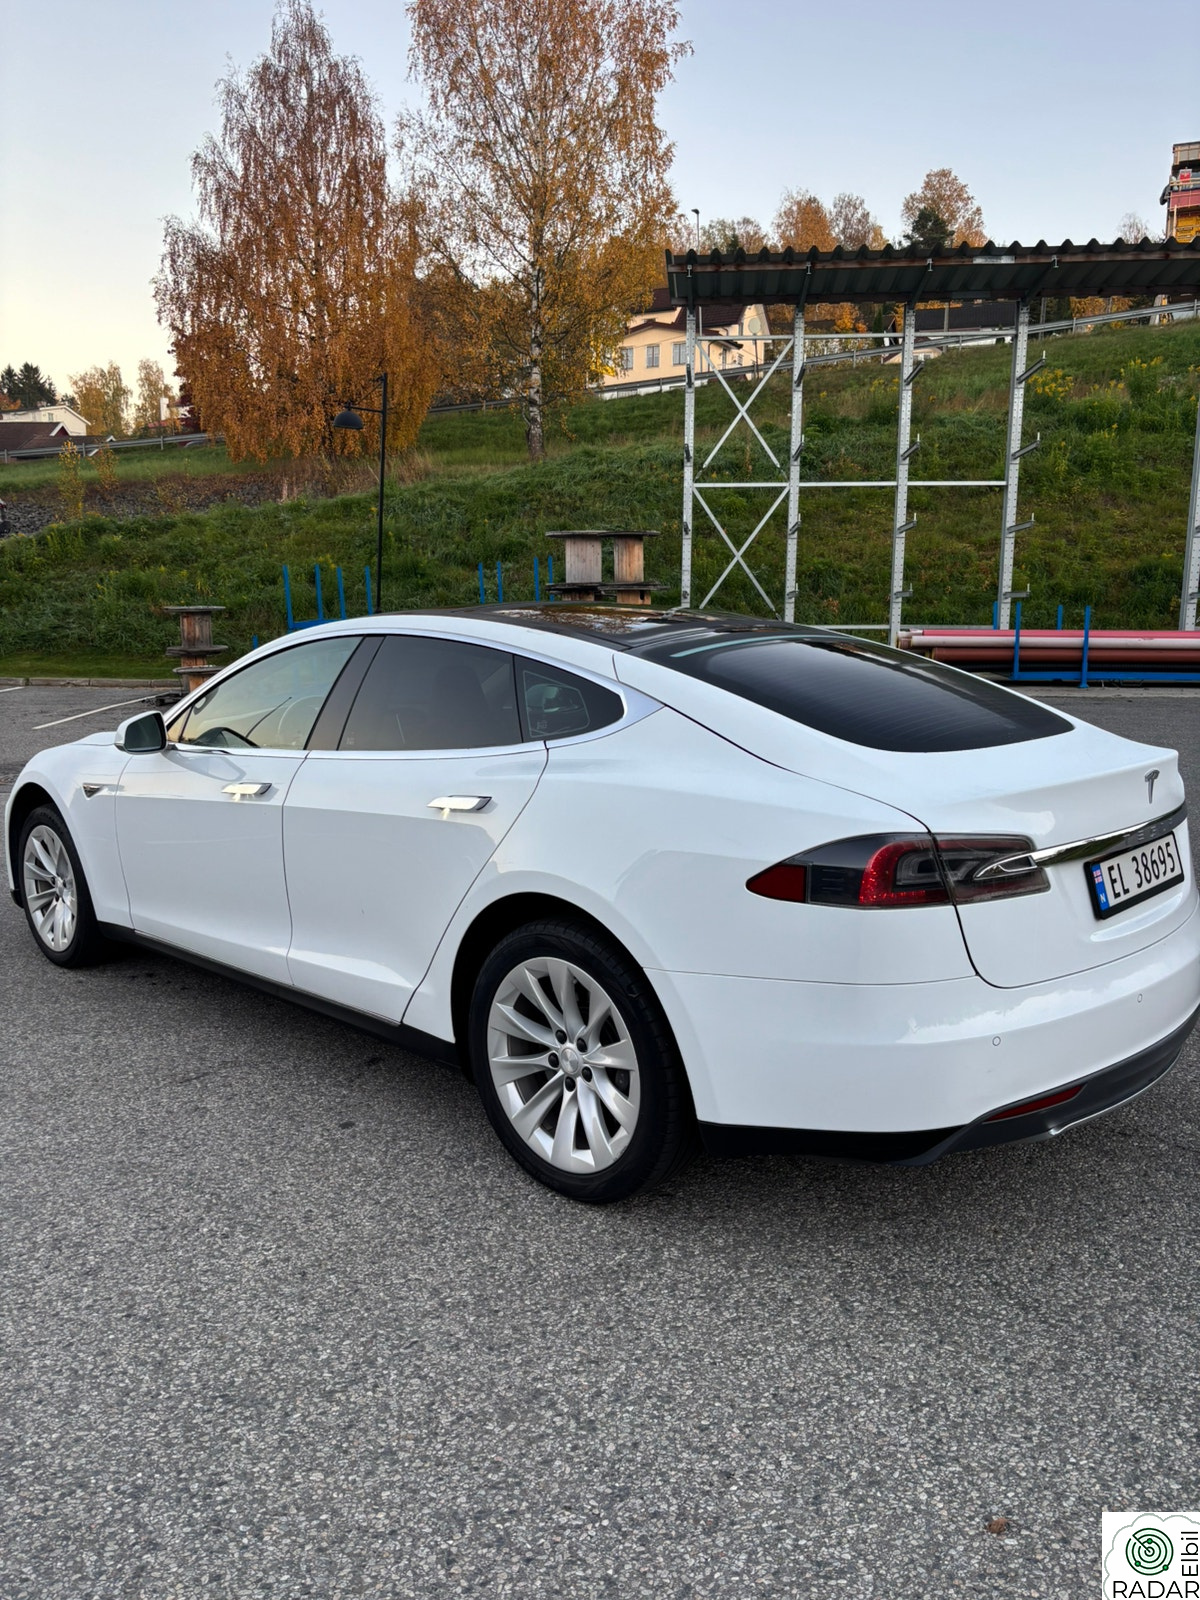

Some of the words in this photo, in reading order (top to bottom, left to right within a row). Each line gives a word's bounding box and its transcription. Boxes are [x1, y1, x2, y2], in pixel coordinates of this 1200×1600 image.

[1107, 863, 1130, 899] EL
[1131, 841, 1176, 889] 38695
[1099, 892, 1107, 904] N
